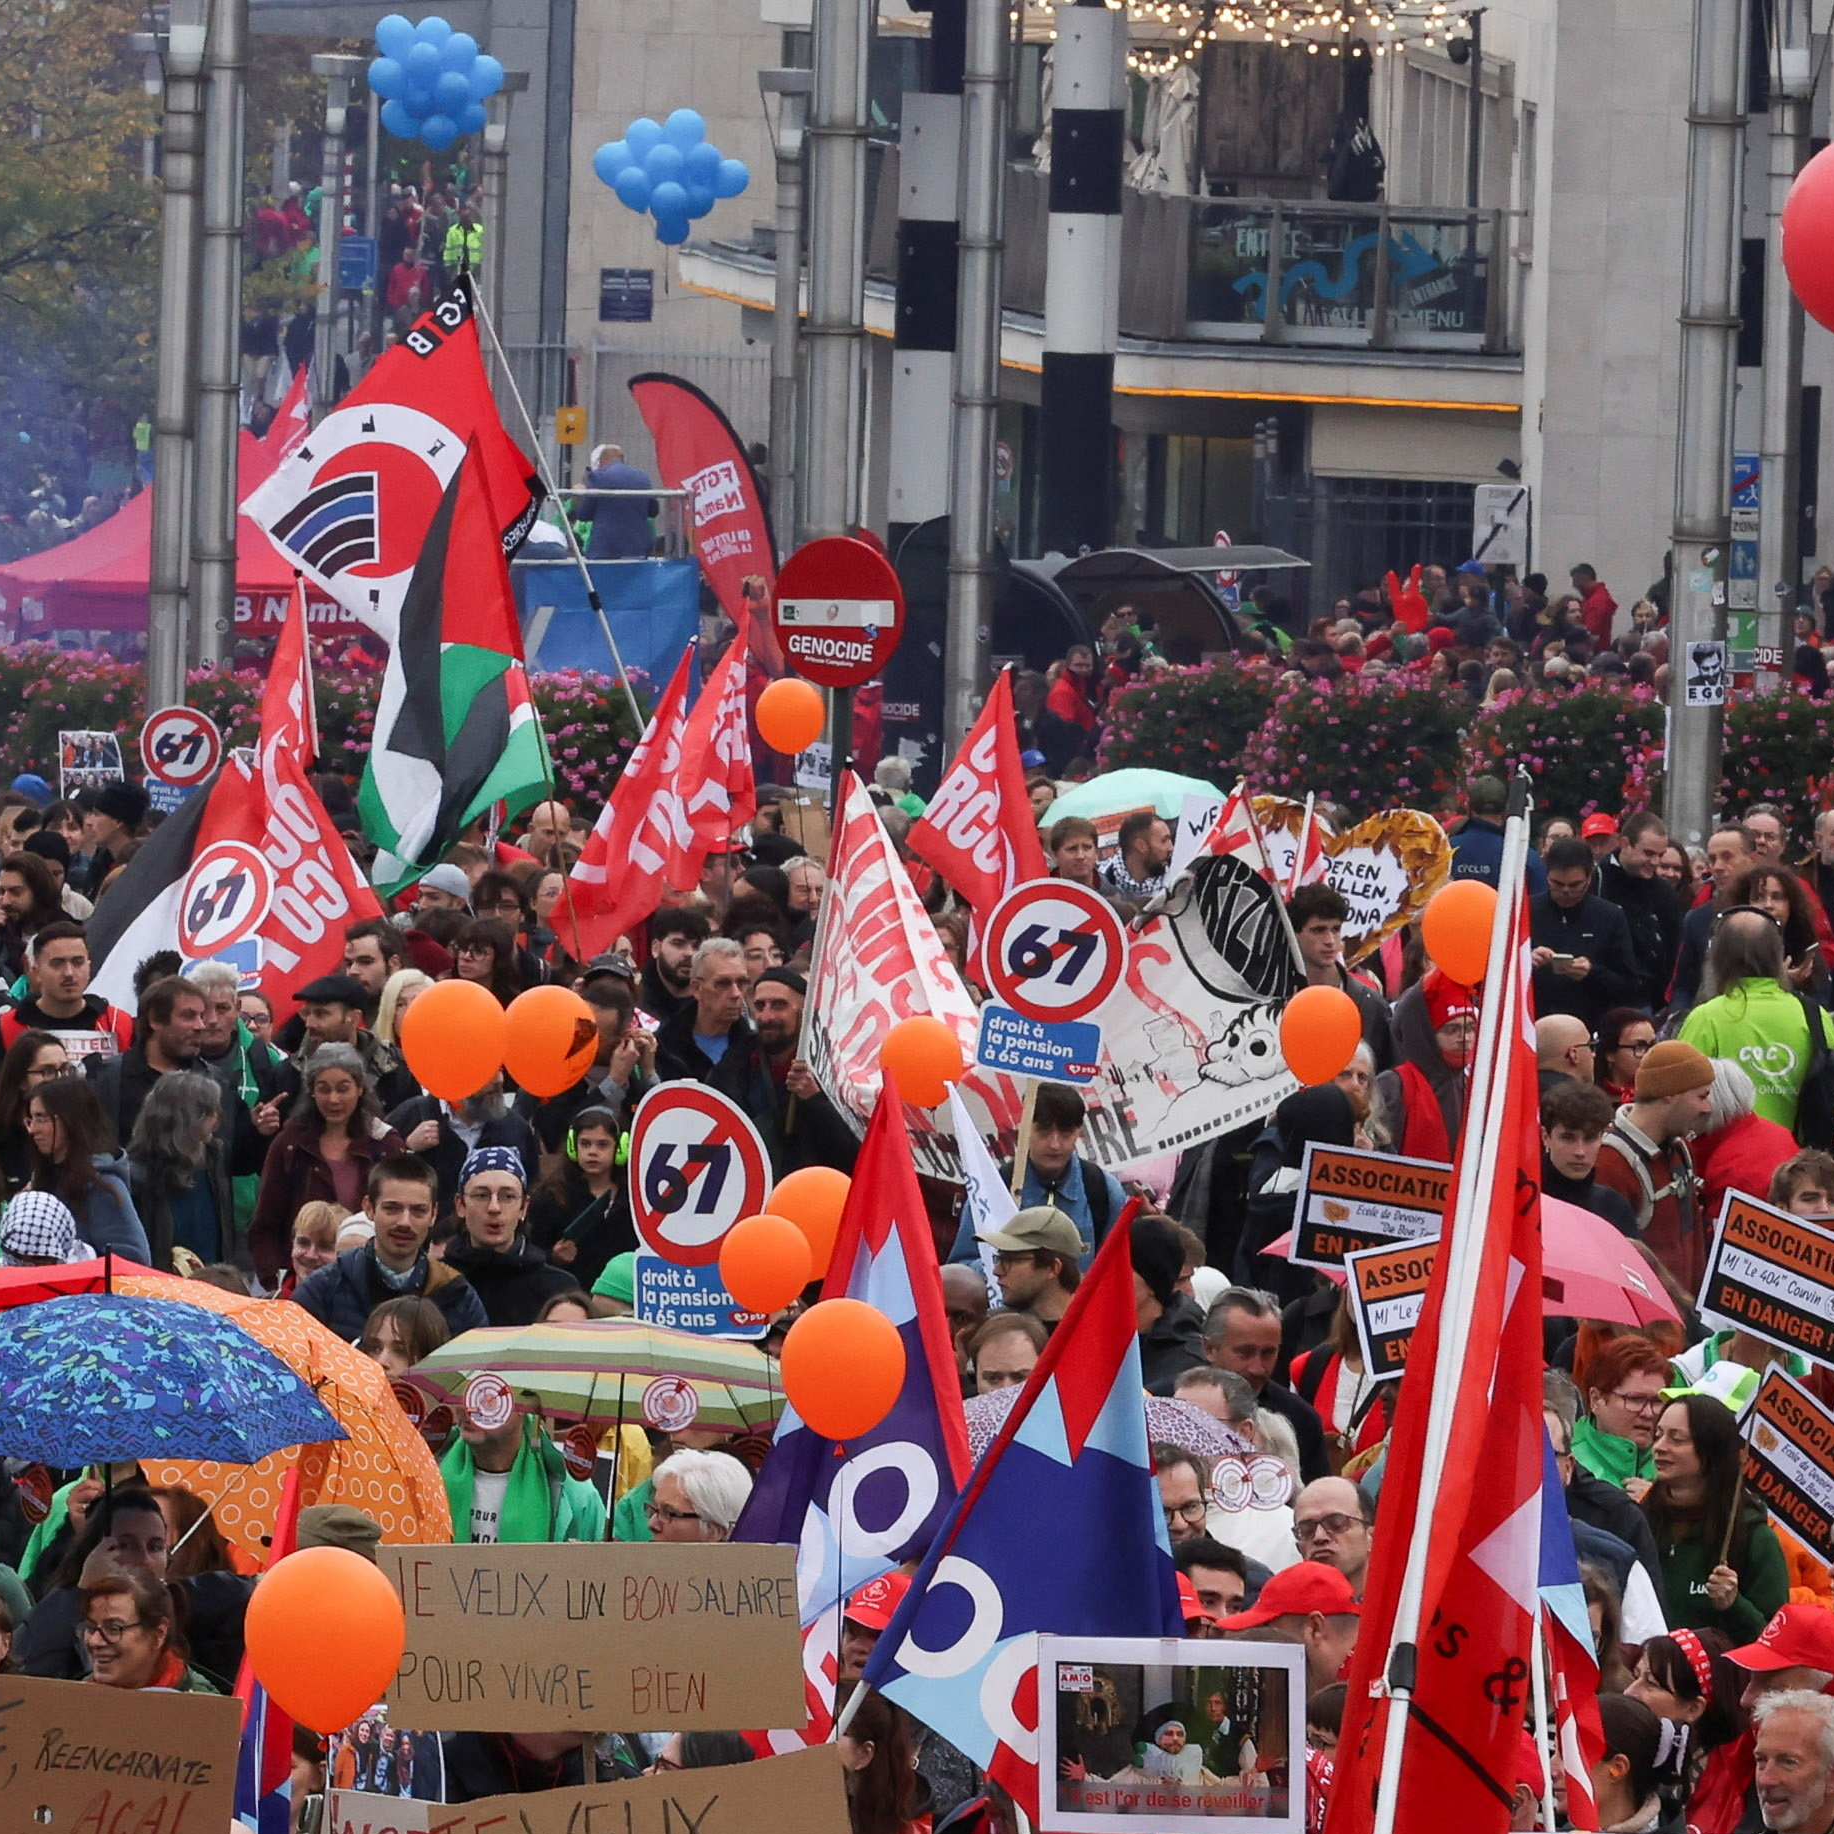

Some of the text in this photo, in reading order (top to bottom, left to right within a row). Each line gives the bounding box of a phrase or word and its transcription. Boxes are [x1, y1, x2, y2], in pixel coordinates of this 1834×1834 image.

[789, 635, 873, 662] GENOCIDE
[153, 731, 206, 766] 67
[187, 873, 248, 934] 67
[1008, 923, 1098, 986] 67
[987, 1030, 1074, 1058] la pension
[988, 1016, 1045, 1039] droit à
[985, 1045, 1055, 1071] à 65 ans
[645, 1141, 734, 1215] 67
[642, 1269, 696, 1288] droit à
[1721, 1251, 1822, 1305] MJ Couvin
[642, 1289, 736, 1308] la pension
[1719, 1285, 1743, 1312] EN
[1747, 1293, 1823, 1346] DANGER
[643, 1307, 718, 1328] à 65 ans
[450, 1566, 678, 1621] VEUX UN BON
[395, 1651, 485, 1703] POUR
[34, 1727, 213, 1786] REENCARNATE
[1086, 1790, 1264, 1809] est l'or de se réveiller
